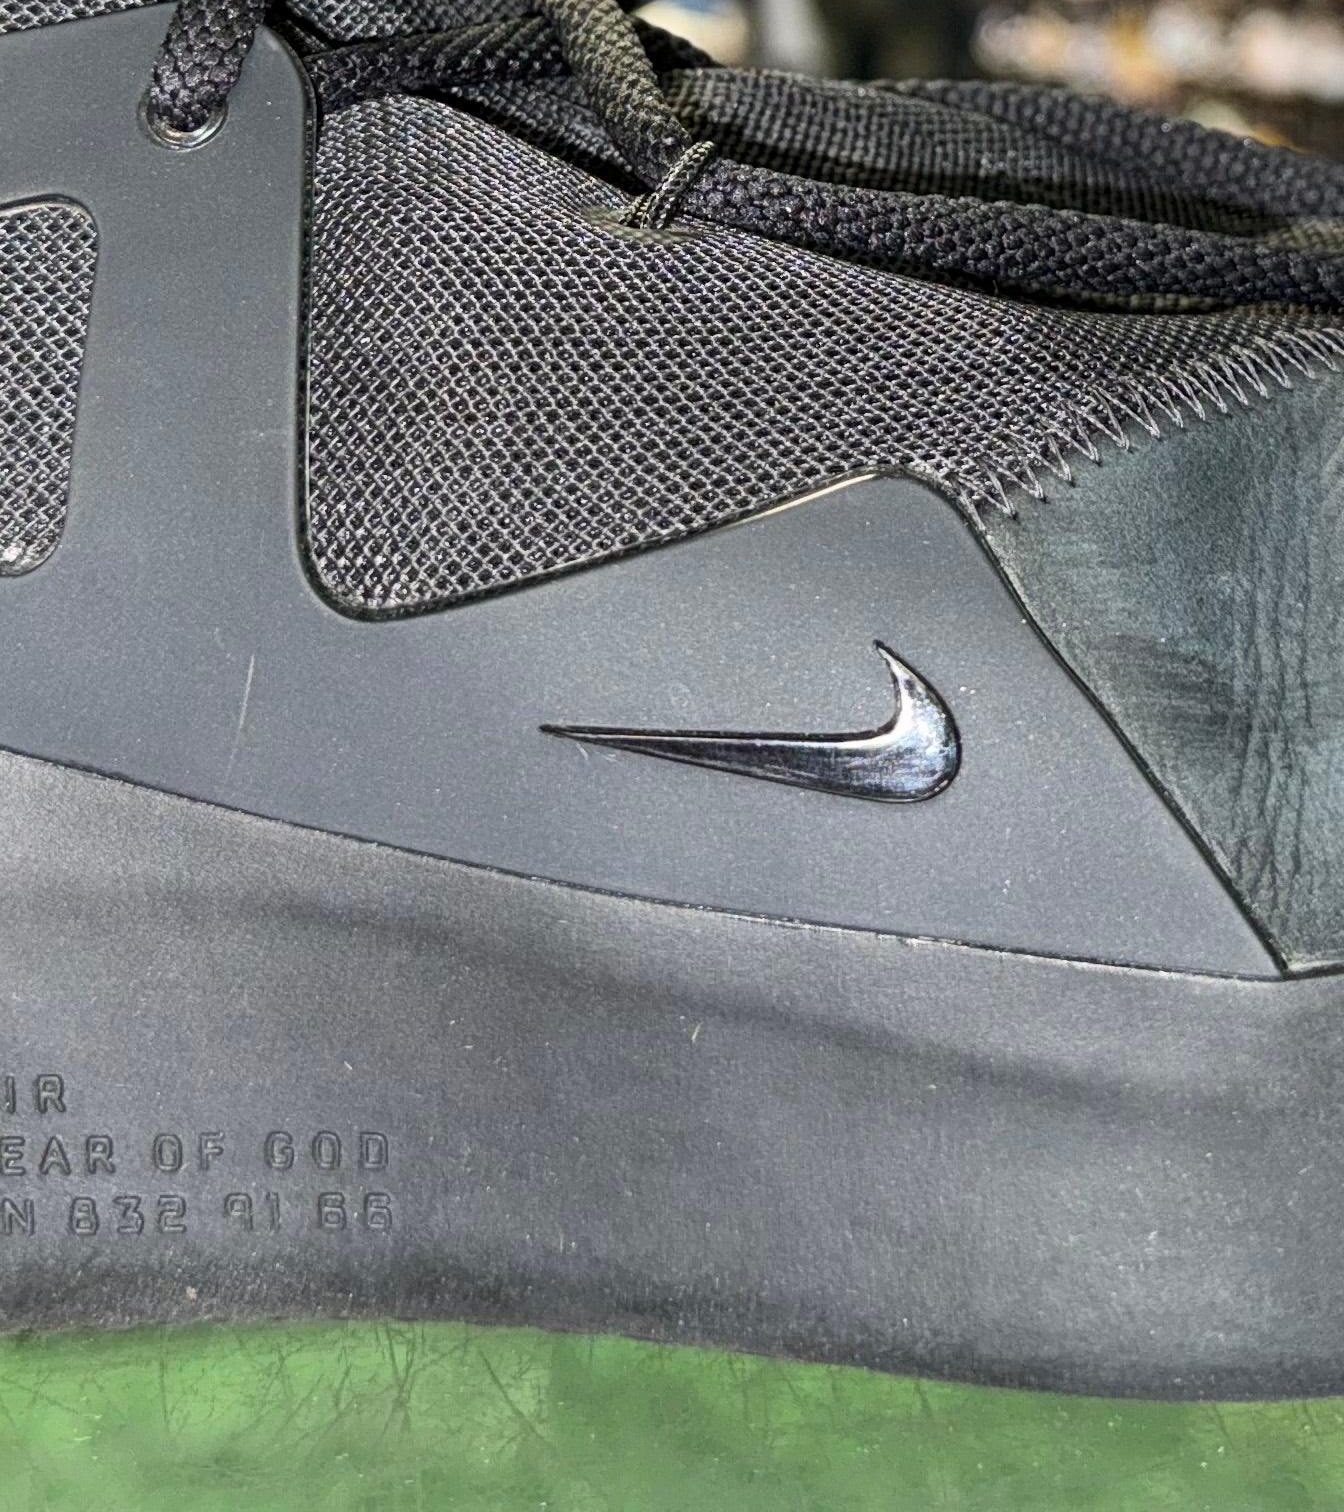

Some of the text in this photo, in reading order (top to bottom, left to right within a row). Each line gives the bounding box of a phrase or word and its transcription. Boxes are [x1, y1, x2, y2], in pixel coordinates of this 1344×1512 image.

[153, 1130, 225, 1172] OF
[263, 1131, 389, 1172] GOD
[69, 1192, 187, 1236] 832
[316, 1191, 394, 1232] 66
